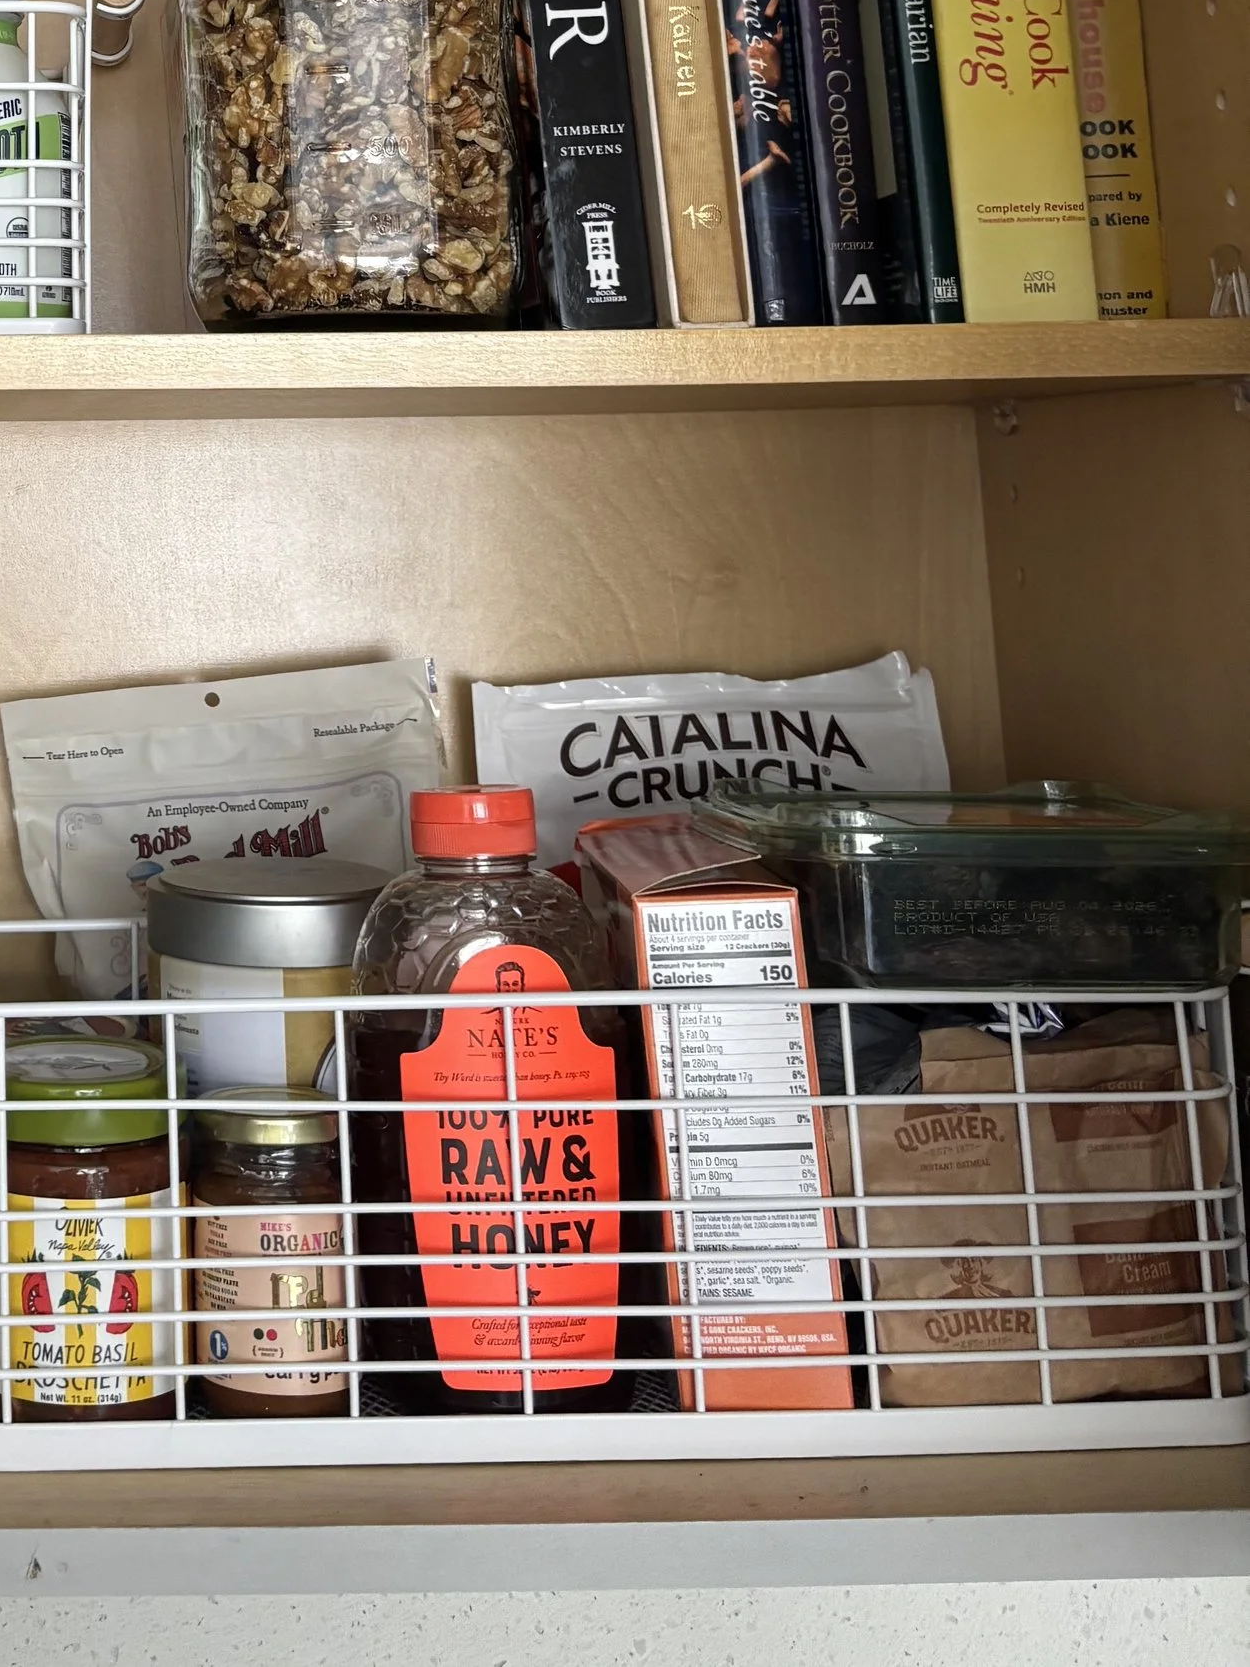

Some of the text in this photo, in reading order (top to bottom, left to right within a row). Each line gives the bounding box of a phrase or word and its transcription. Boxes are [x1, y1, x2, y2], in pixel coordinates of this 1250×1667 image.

[668, 5, 700, 98] Katzen
[747, 53, 772, 123] table
[553, 122, 626, 137] KIMBERLY
[1080, 119, 1136, 136] OOK
[559, 144, 623, 157] STEVENS
[824, 70, 860, 229] COOKBOOK
[1081, 143, 1138, 161] OOK
[976, 201, 1085, 215] Completely Revised
[1106, 212, 1151, 227] Kiene
[932, 277, 956, 286] TIME
[1024, 282, 1056, 294] HMH
[313, 721, 396, 738] Resealable Package
[559, 709, 868, 778] CATALINA
[46, 746, 124, 761] Tear Here to Open
[607, 757, 821, 809] CRUNCH
[146, 797, 310, 818] An Employee-Owned Company
[130, 824, 192, 860] Bob's
[647, 908, 784, 934] Nutrition Facts
[893, 912, 978, 923] PRODUCT
[650, 944, 685, 954] Serving
[653, 965, 793, 985] Calories 150
[692, 1056, 804, 1070] 280mg 12%
[685, 1072, 753, 1084] Carbohydrate 17g
[533, 1110, 594, 1129] PURE
[712, 1114, 810, 1128] 0g Added Sugars 0%
[441, 1134, 597, 1186] RAW &
[714, 1154, 815, 1168] 0mcg 0%
[955, 1159, 991, 1171] OATMEAL
[708, 1168, 816, 1182] 80mg 6%
[694, 1183, 817, 1196] 1.7mg 10%
[260, 1222, 292, 1232] MIKE'S
[48, 1237, 114, 1260] Napa Valley
[260, 1231, 339, 1252] ORGANIC
[451, 1219, 596, 1270] HONEY
[1122, 1258, 1172, 1284] Cream
[473, 1332, 586, 1346] & flavor
[21, 1340, 138, 1365] TOMATO BASIL
[97, 1391, 122, 1404] (314g)
